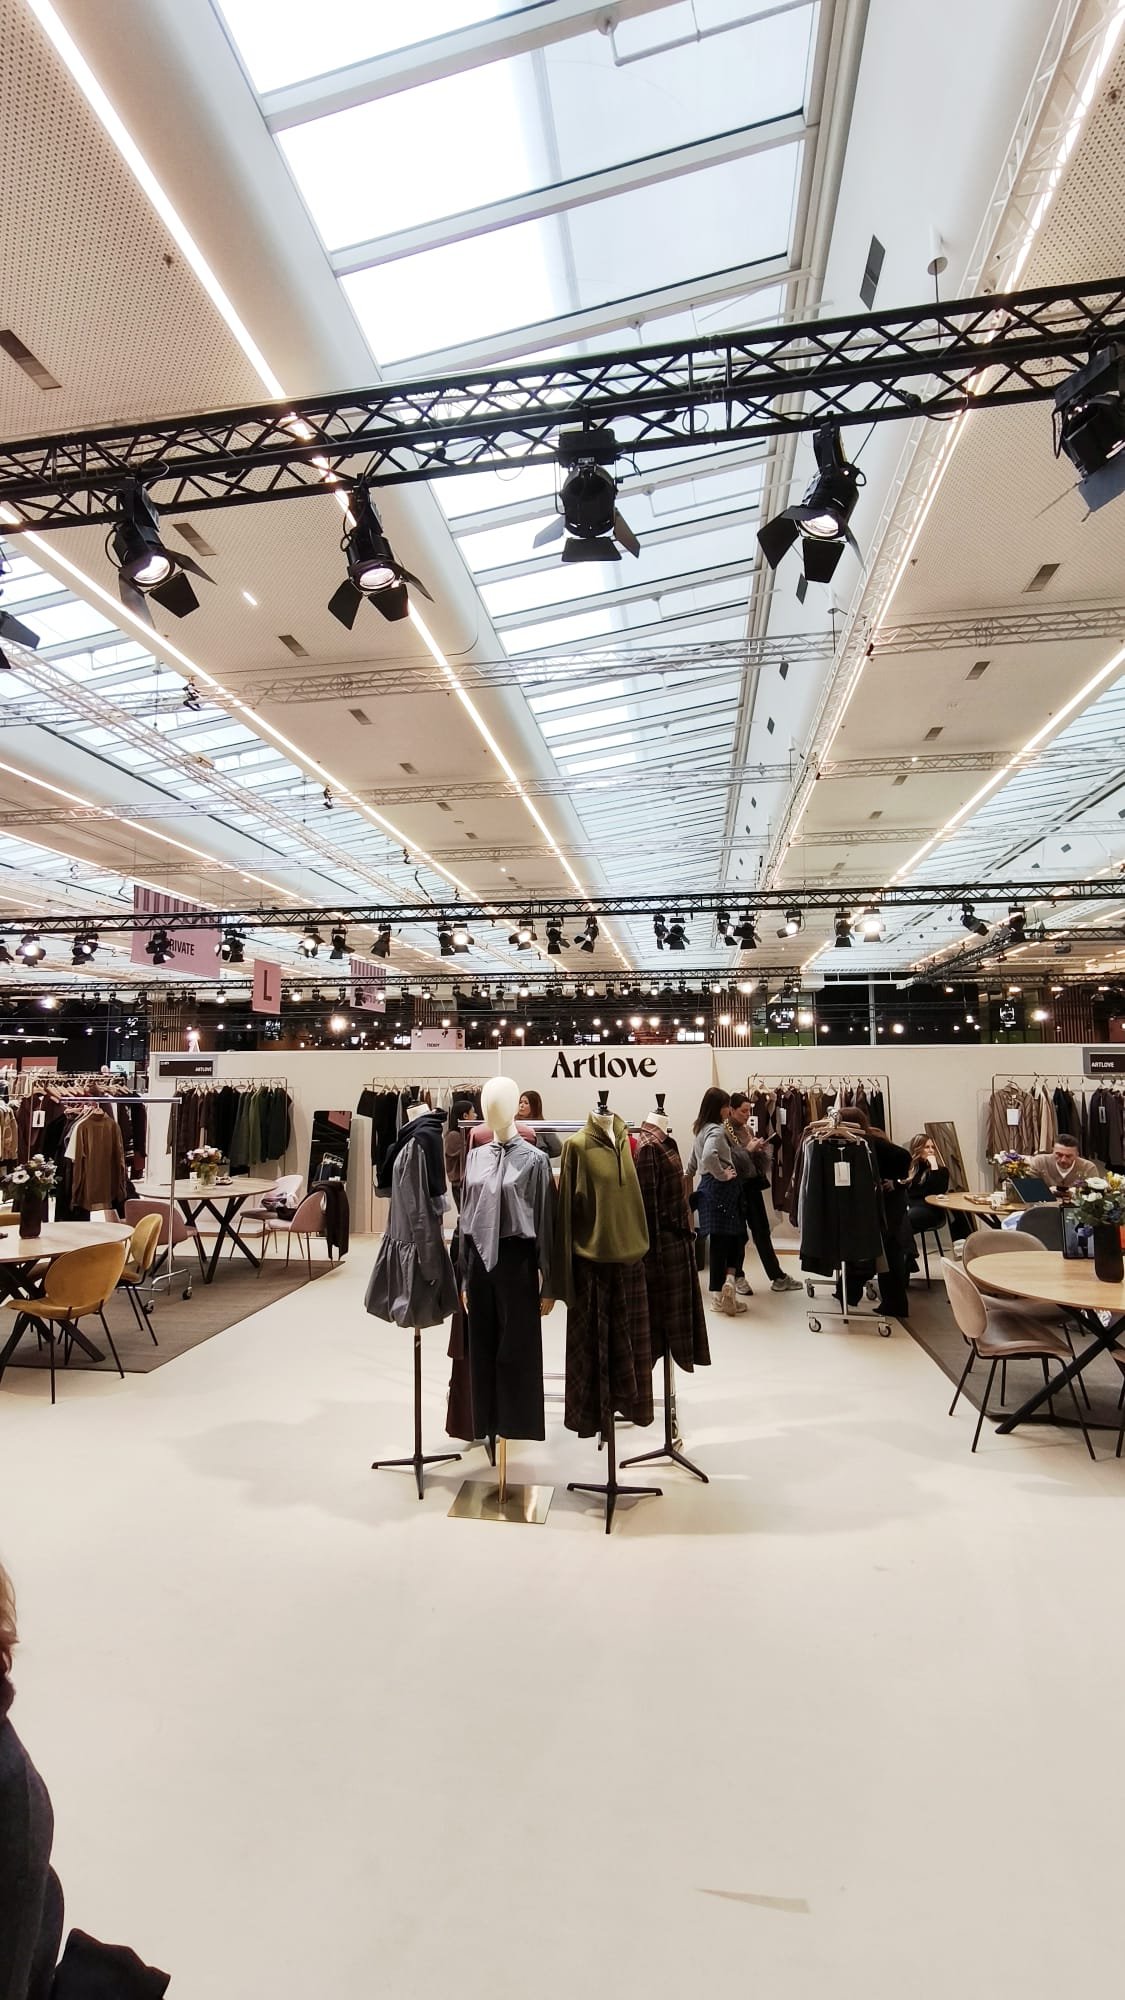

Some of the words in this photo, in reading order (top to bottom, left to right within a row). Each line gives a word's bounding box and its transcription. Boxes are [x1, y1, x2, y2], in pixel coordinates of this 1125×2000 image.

[169, 938, 195, 956] RIVATE
[264, 969, 272, 1001] L
[551, 1051, 657, 1078] Artlove
